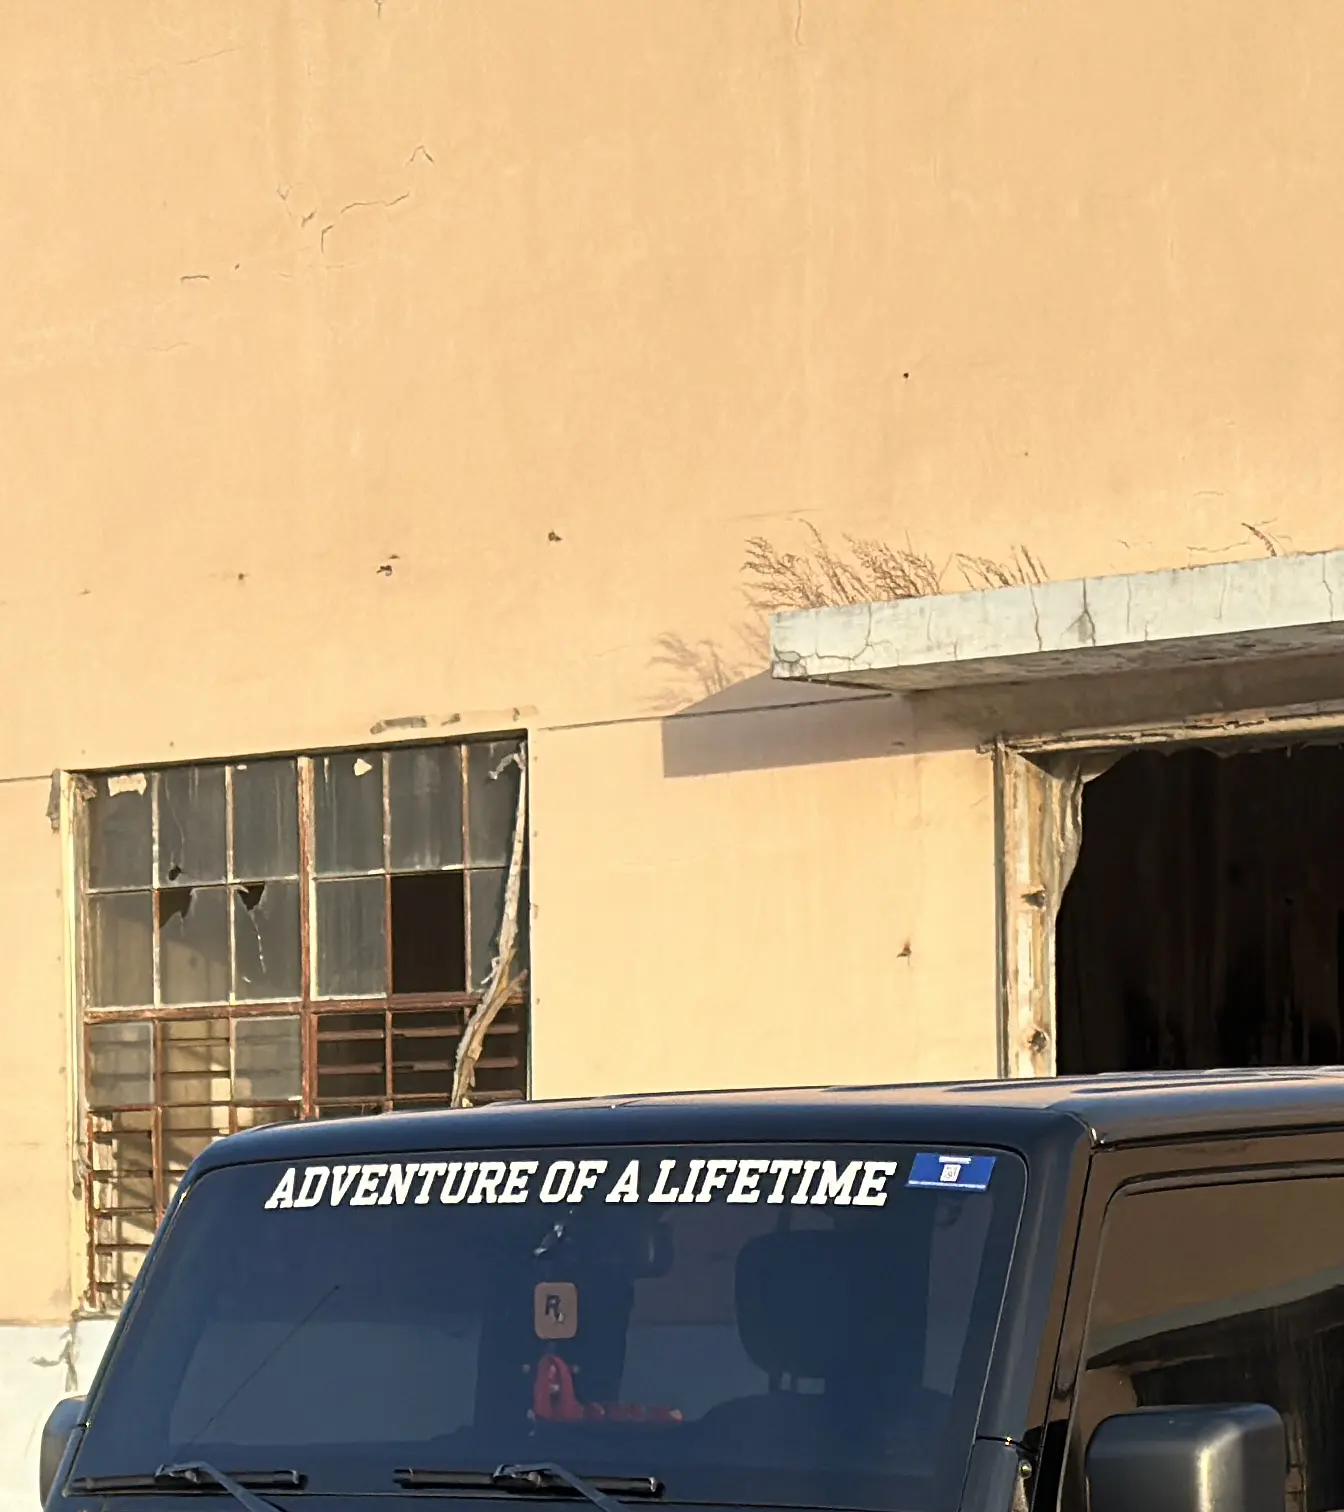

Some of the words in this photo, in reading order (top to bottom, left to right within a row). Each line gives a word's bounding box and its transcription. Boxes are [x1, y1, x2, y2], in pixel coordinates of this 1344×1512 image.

[264, 1160, 539, 1208] ADVENTURE
[539, 1160, 609, 1203] OF
[605, 1160, 642, 1203] A
[647, 1159, 898, 1207] LIFETIME
